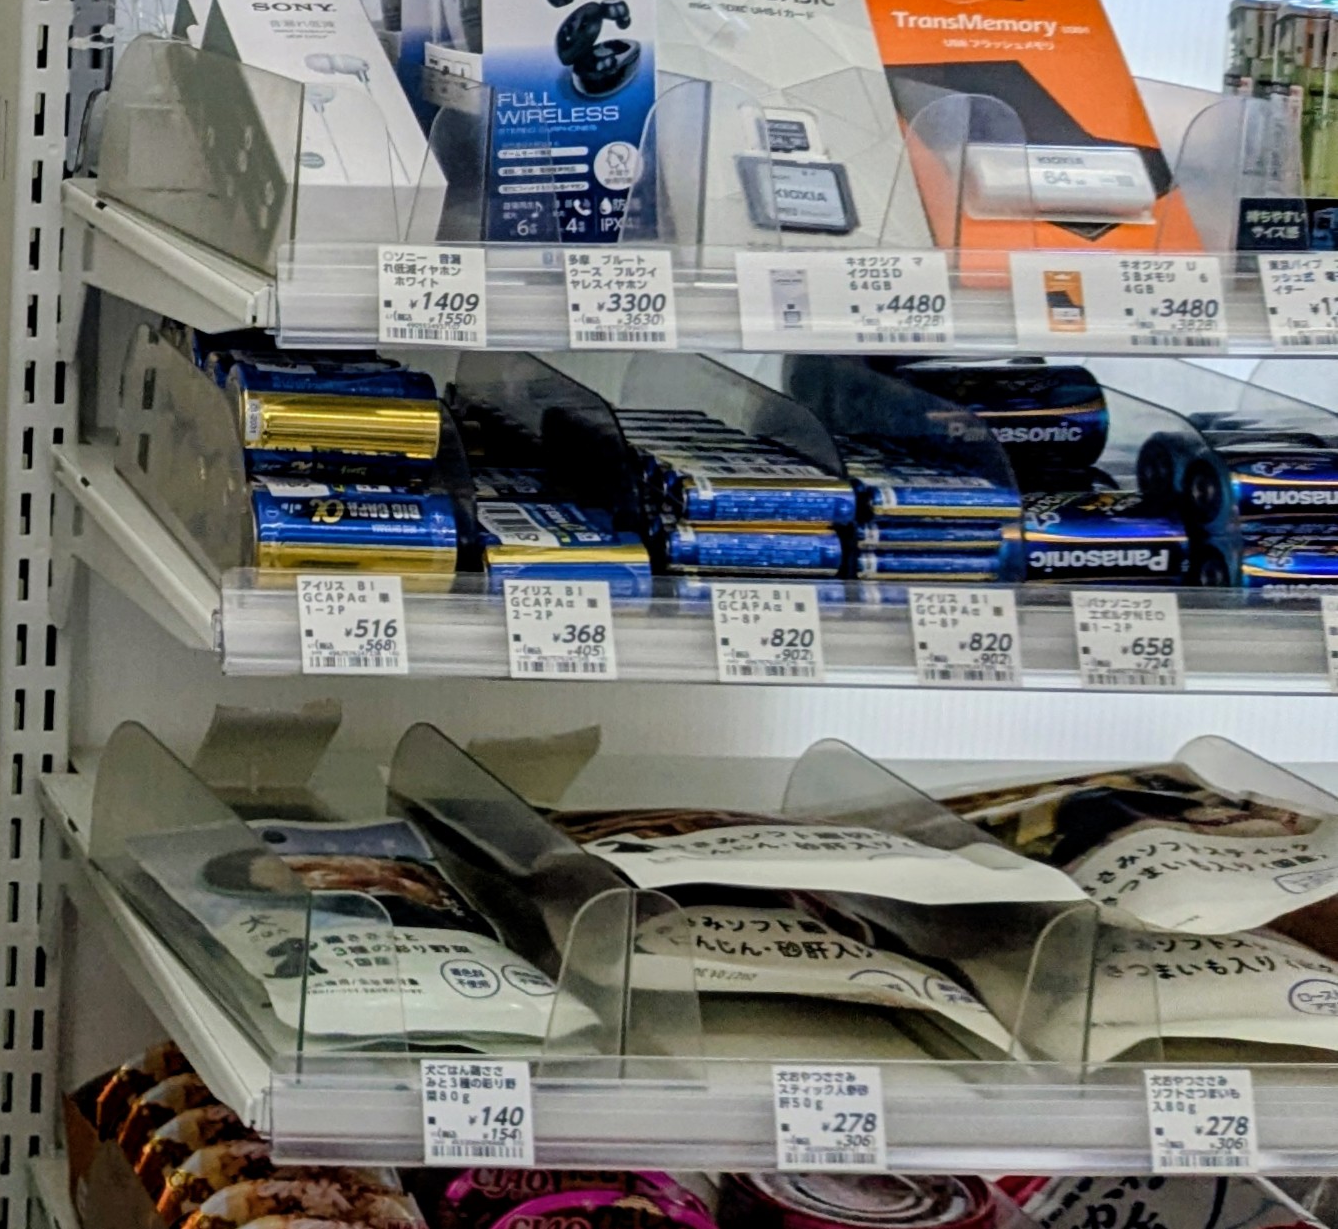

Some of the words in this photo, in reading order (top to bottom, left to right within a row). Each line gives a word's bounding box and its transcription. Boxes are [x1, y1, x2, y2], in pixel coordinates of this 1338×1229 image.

[251, 1, 333, 14] SONY
[891, 11, 1057, 35] TransMemory
[497, 91, 557, 107] FULL
[497, 106, 620, 124] WIRELESS
[602, 255, 645, 266] ブルート
[395, 277, 439, 288] ホワイト
[570, 279, 647, 290] ヤレスイヤホン
[949, 421, 1083, 443] Panasonic
[1029, 549, 1170, 572] Panasonic
[302, 581, 345, 591] アイリス
[509, 586, 552, 596] アイリス
[716, 589, 760, 600] アイリス
